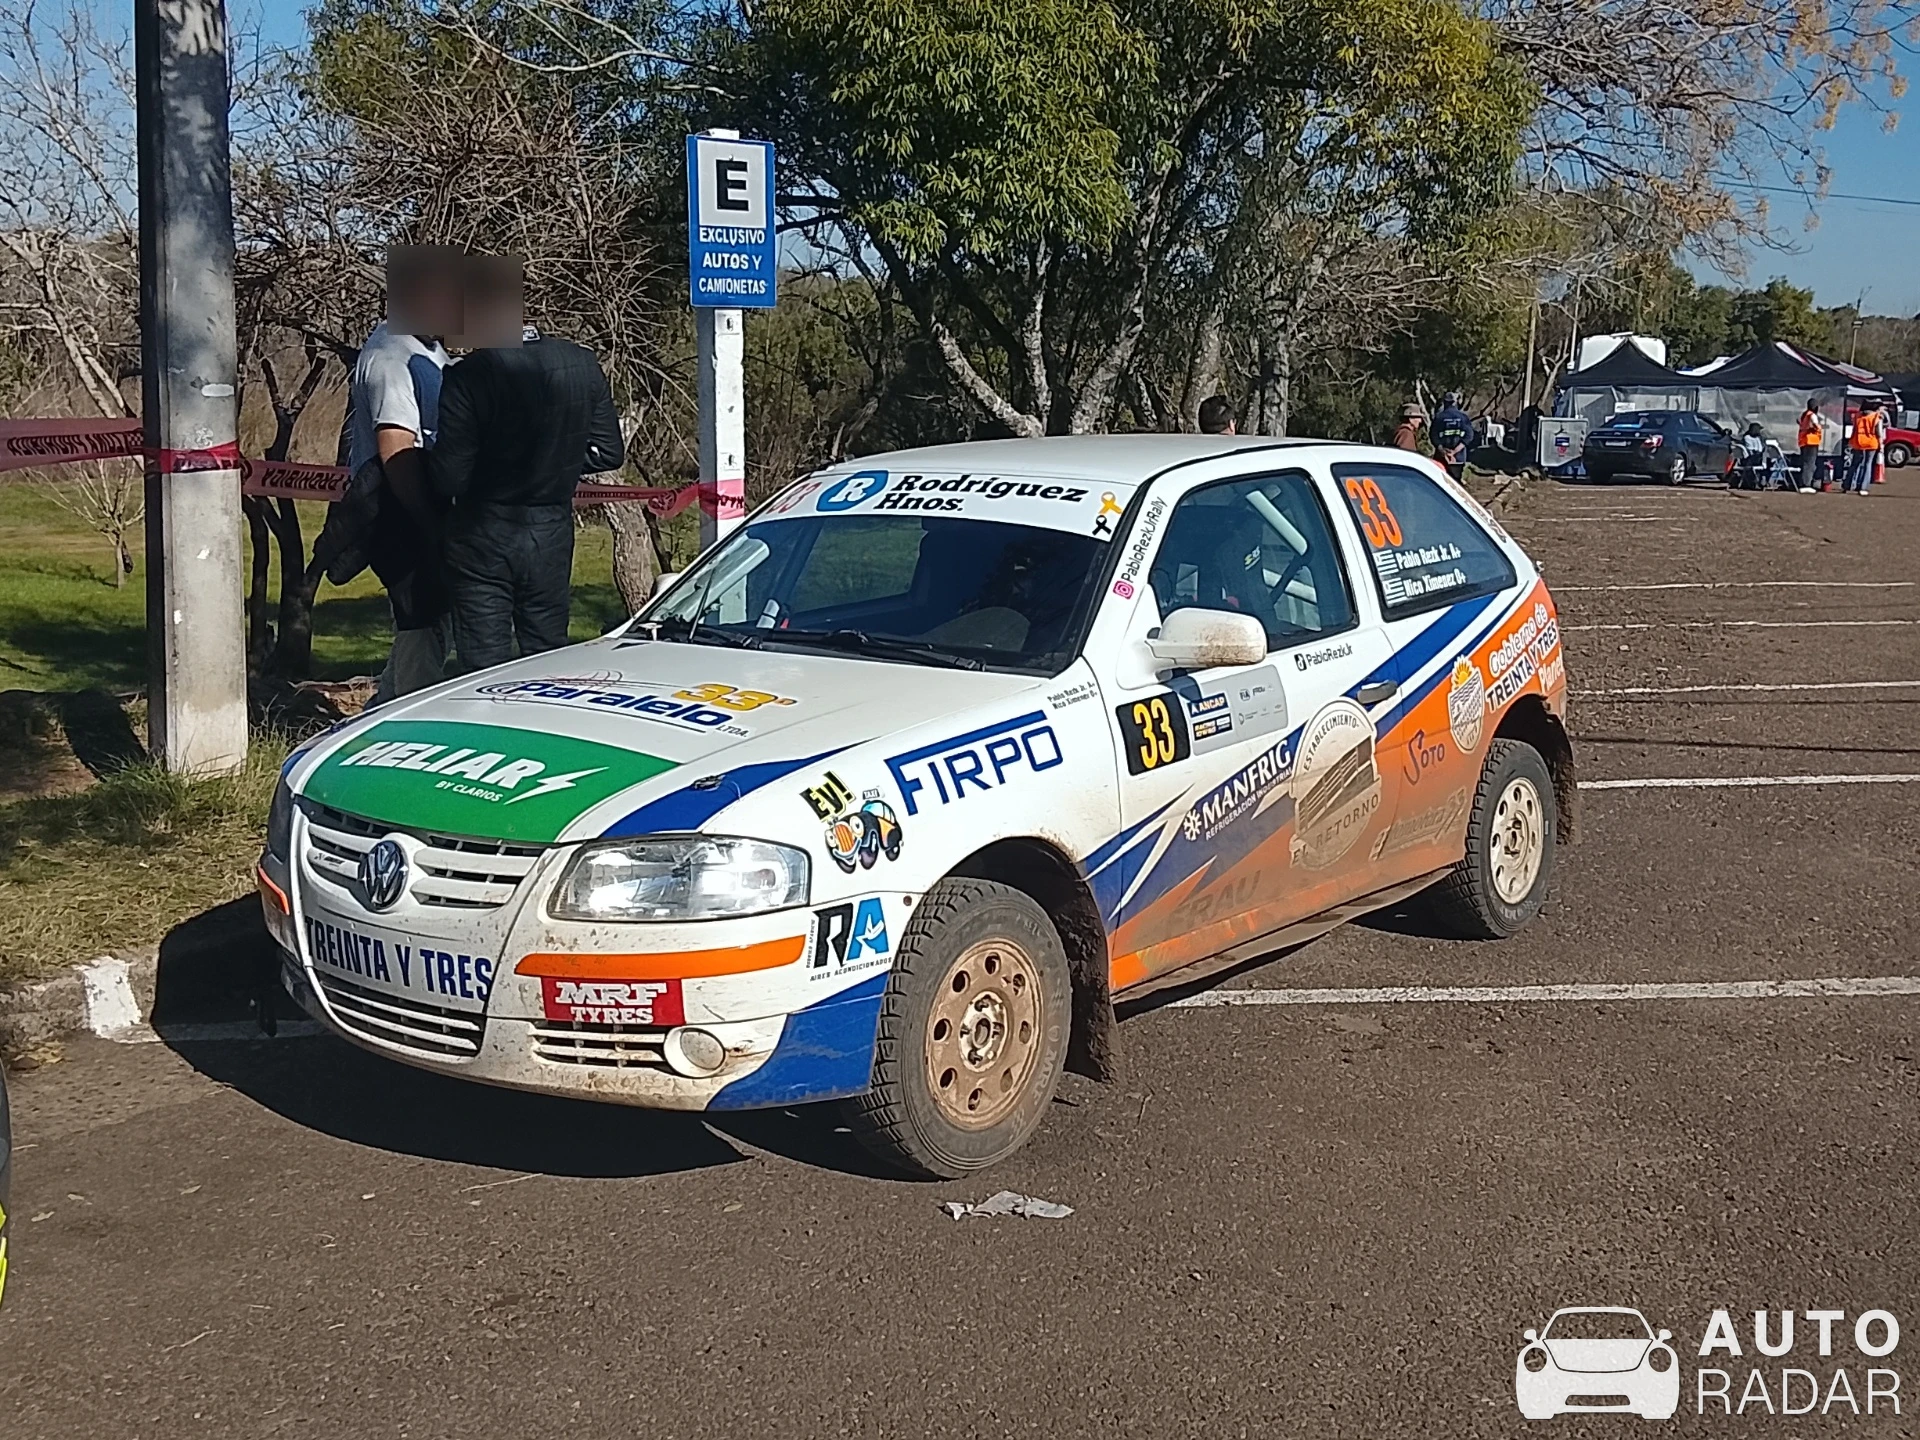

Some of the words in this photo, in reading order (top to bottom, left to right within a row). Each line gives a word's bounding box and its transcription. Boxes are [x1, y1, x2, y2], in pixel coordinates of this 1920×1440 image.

[716, 159, 750, 211] E
[699, 227, 765, 246] EXCLUSIVO
[702, 252, 749, 270] AUTOS
[752, 255, 763, 270] Y
[699, 277, 766, 294] CAMIONETAS
[873, 492, 965, 513] Hnos.
[1345, 477, 1403, 549] 33
[1395, 550, 1420, 570] Pablo
[1403, 579, 1424, 597] Nico
[1490, 621, 1535, 672] Gobierno
[1534, 604, 1548, 627] de
[1486, 655, 1532, 710] TREINTA
[1538, 620, 1558, 652] TRES
[1133, 698, 1176, 769] 33
[339, 741, 546, 789] HELIAR
[883, 710, 1064, 817] FIRPO
[1202, 739, 1291, 828] MANFRIG
[435, 780, 451, 791] BY
[450, 782, 504, 802] CLARIOS
[1316, 792, 1379, 846] RETORNO
[304, 915, 391, 983] TREINTA
[395, 944, 411, 987] Y
[419, 949, 493, 1002] TRES
[555, 982, 668, 1006] MRF
[571, 1007, 654, 1025] TYRES
